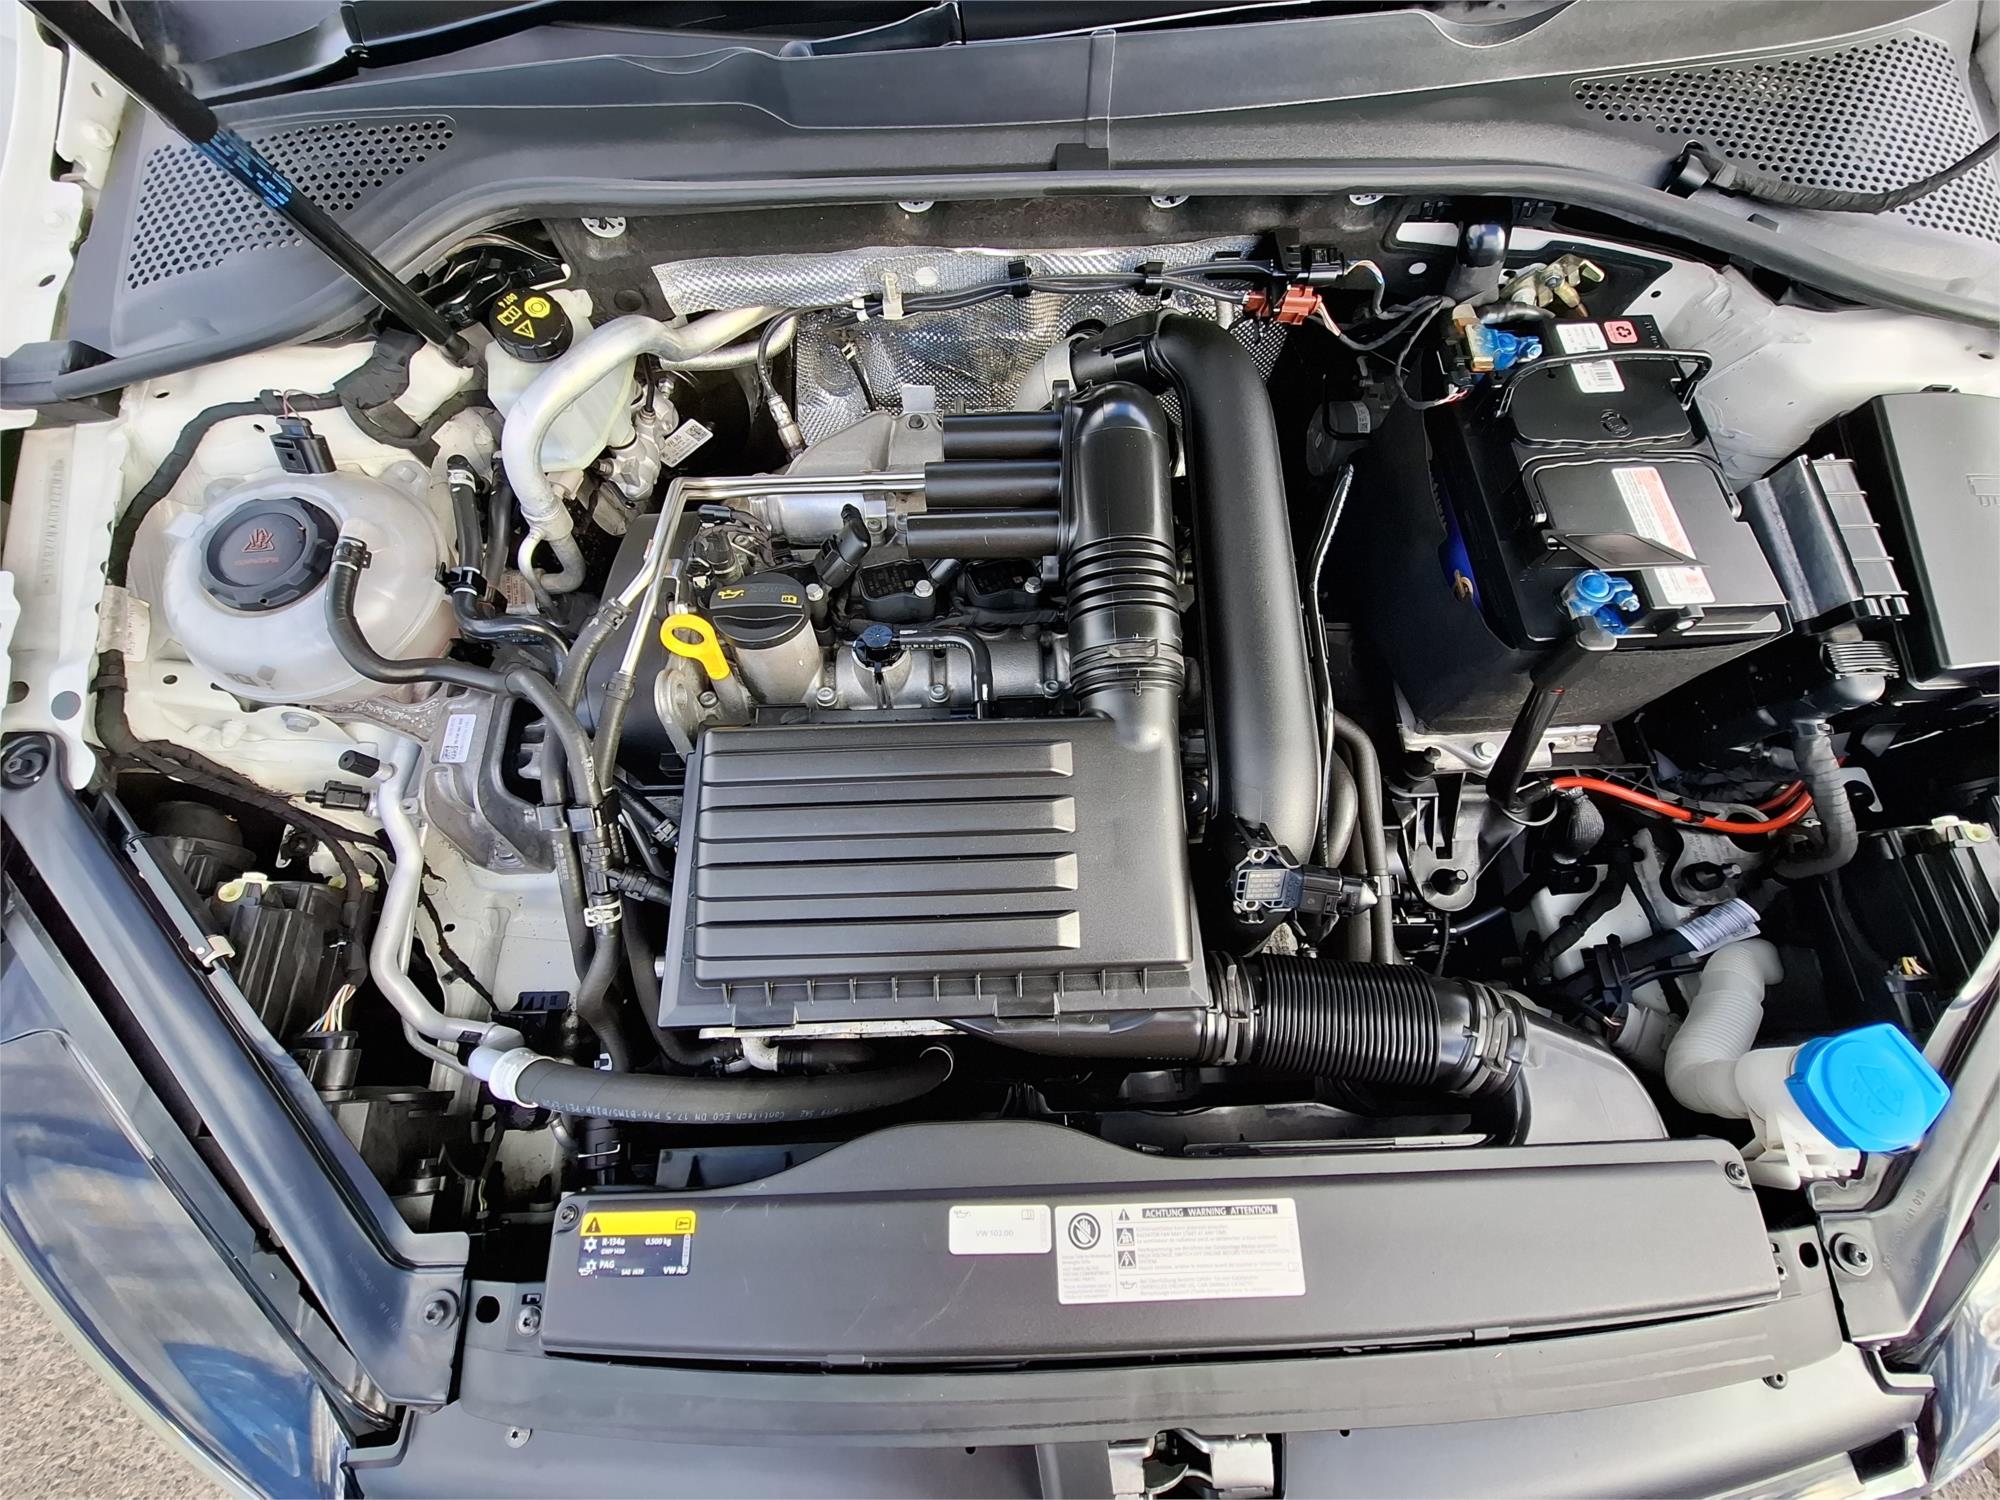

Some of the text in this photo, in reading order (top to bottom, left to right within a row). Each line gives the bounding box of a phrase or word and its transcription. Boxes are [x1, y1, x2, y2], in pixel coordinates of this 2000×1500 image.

[713, 1111, 731, 1120] ECO
[1145, 1205, 1272, 1218] ACHTUNG WARNING ATTENTION
[599, 1260, 615, 1269] PAG
[663, 1266, 688, 1275] VW AG
